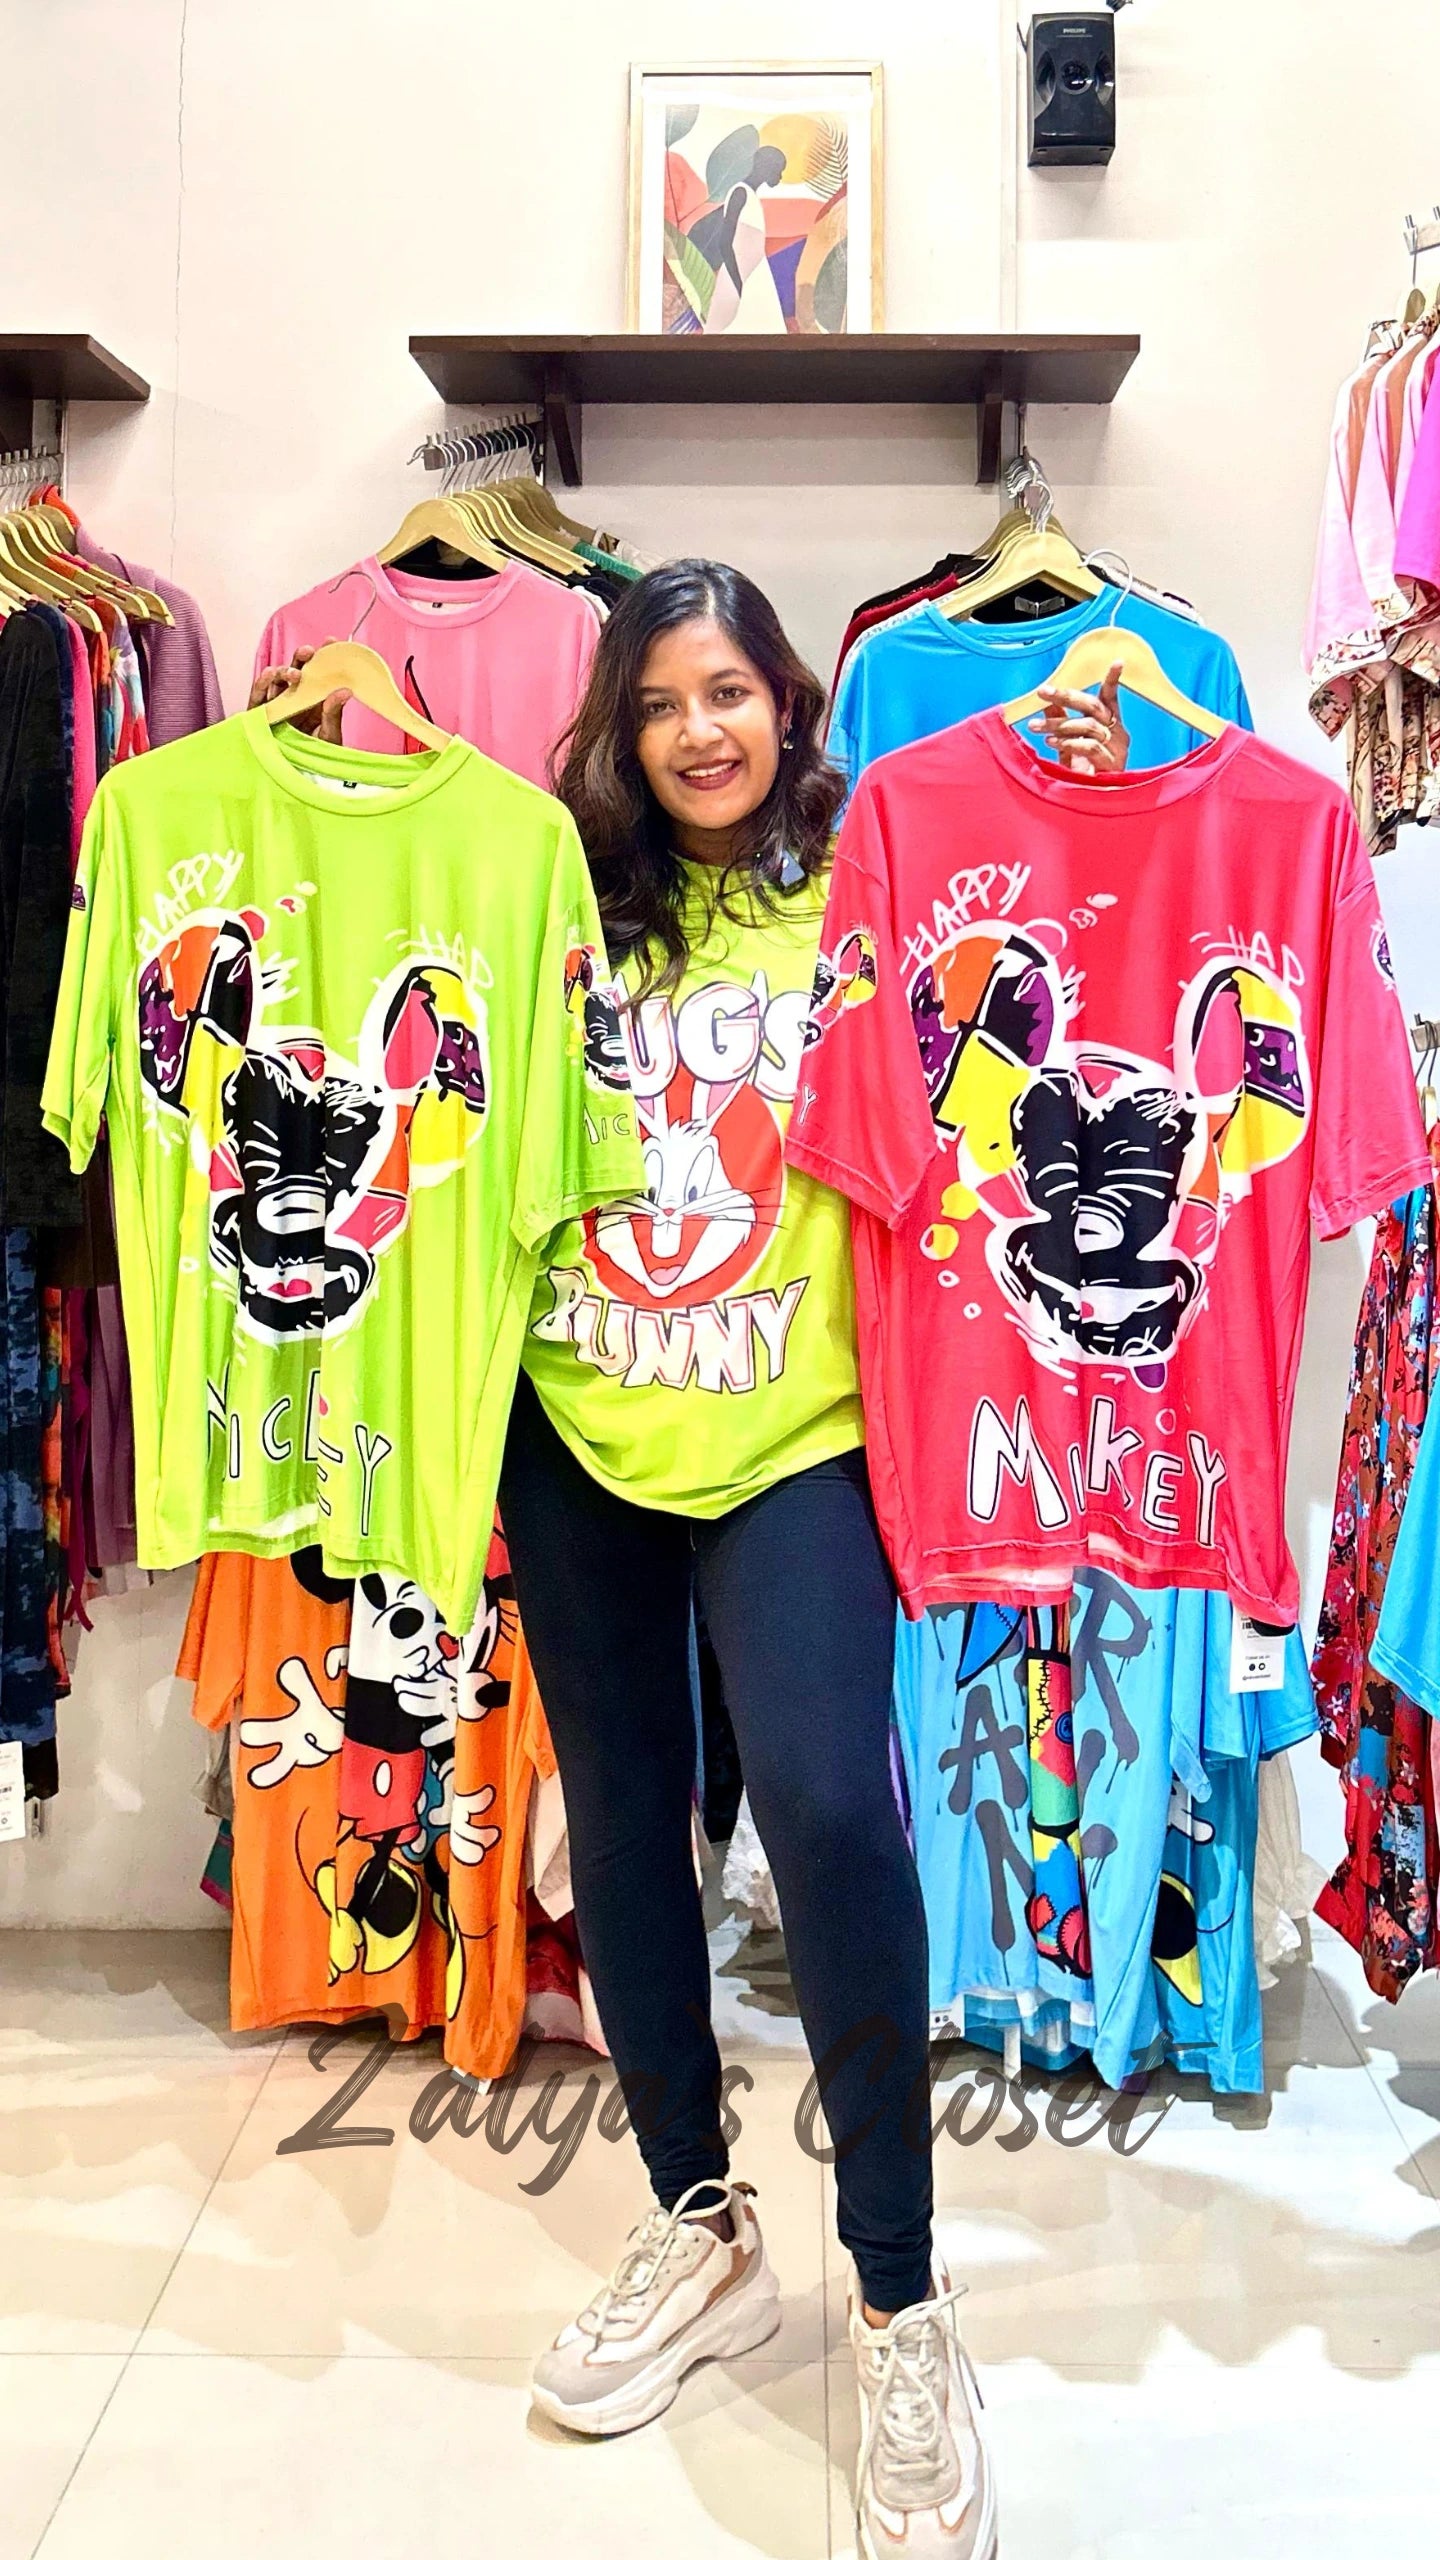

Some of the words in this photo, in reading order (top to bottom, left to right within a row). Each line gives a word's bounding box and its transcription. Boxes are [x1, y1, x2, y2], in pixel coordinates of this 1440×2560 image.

[135, 848, 246, 958] HAPPY
[899, 860, 1032, 976] HAPPY
[617, 980, 814, 1104] UGS
[529, 1265, 812, 1395] BUNNY
[967, 1394, 1228, 1548] MIKEY
